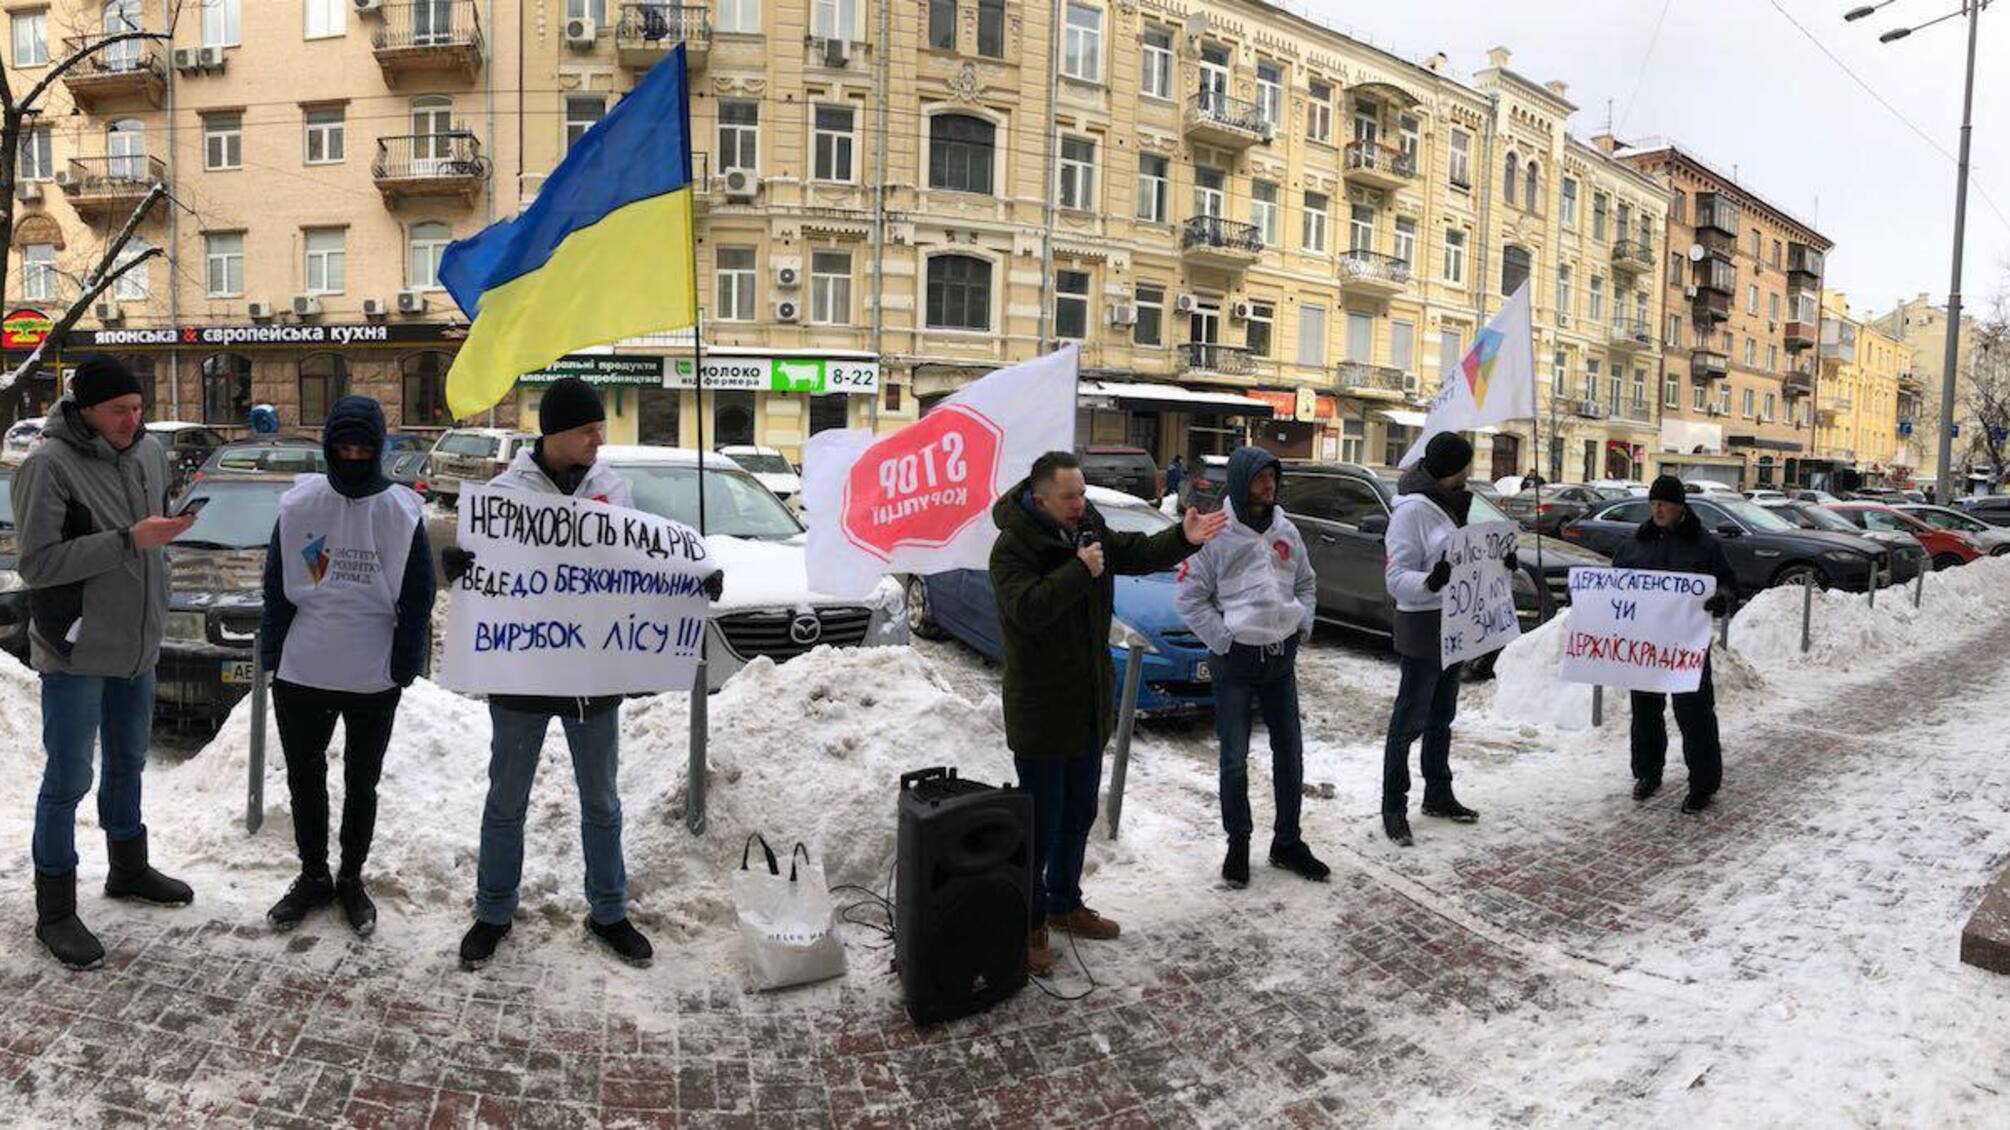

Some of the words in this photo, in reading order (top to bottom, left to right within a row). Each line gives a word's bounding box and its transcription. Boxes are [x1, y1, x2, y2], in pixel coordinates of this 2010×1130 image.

[94, 330, 178, 344] японська
[183, 326, 198, 342] &
[203, 324, 325, 345] європейська
[330, 326, 387, 344] кухня
[834, 368, 874, 386] 8-22
[624, 517, 707, 561] КАДРІВ
[1611, 599, 1636, 620] ЧИ
[475, 621, 586, 651] ВИРУБОК
